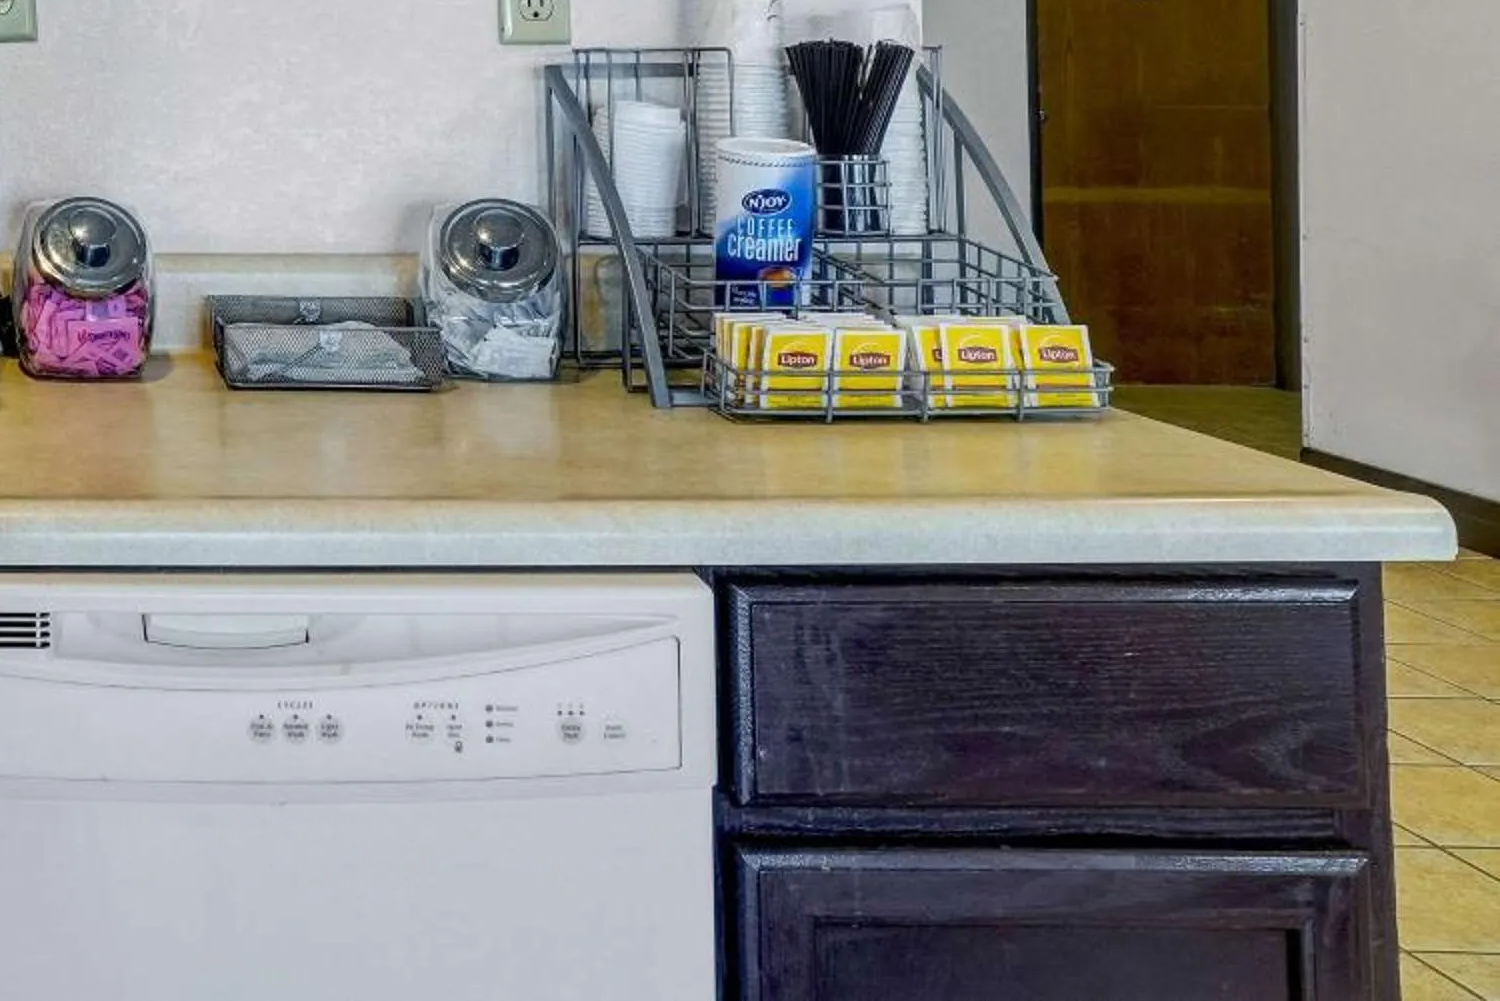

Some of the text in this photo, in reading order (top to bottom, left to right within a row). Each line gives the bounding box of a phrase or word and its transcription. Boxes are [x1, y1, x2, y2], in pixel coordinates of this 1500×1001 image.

[736, 216, 793, 238] COFFEE
[727, 233, 801, 262] creamer
[781, 354, 815, 366] Lipton
[852, 354, 887, 367] Lipton
[960, 350, 995, 362] Lipton
[1041, 350, 1077, 362] Lipton
